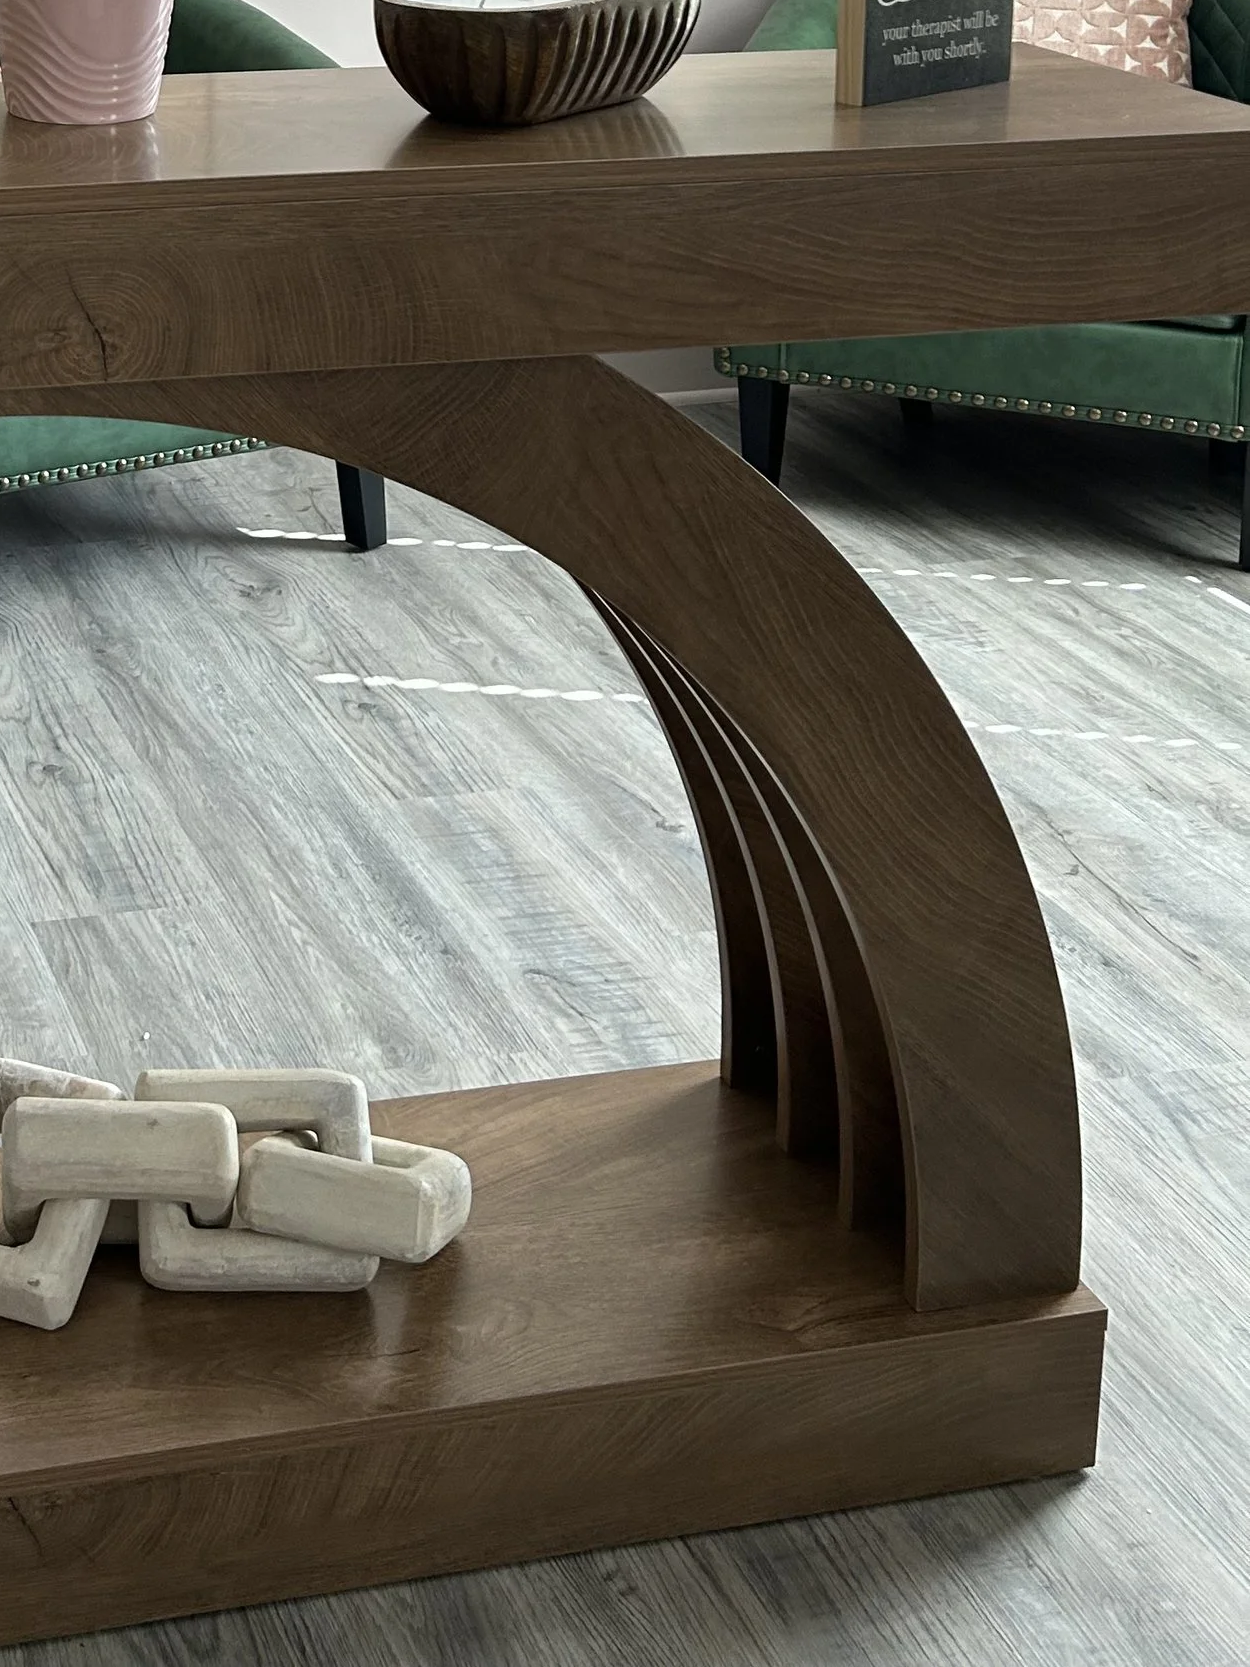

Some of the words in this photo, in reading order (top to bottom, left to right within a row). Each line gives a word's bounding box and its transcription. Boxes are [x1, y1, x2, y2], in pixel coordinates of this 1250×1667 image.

[882, 26, 909, 46] your
[910, 15, 961, 38] therapist
[963, 10, 984, 29] will
[985, 9, 999, 27] be
[893, 45, 920, 66] with
[920, 47, 943, 67] you
[944, 36, 987, 59] shortly.
